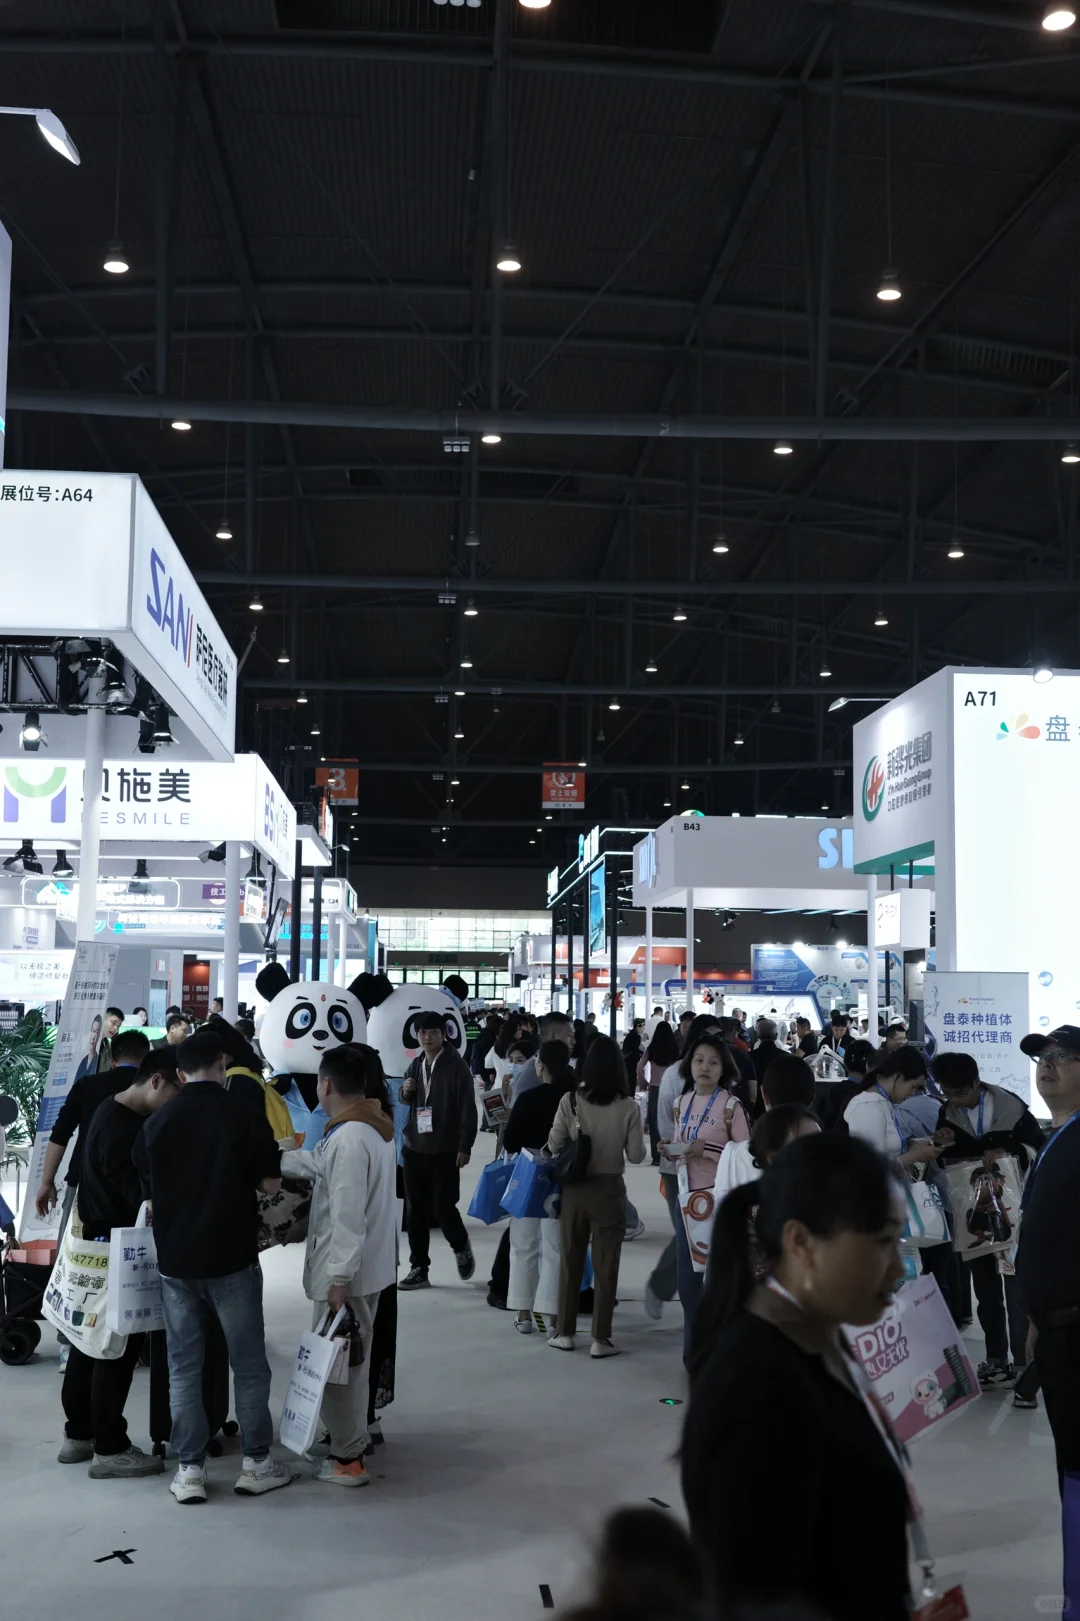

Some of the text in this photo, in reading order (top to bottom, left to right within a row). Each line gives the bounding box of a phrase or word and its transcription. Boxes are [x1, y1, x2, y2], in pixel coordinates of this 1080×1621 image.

[1, 485, 93, 503] 展位号:A64
[964, 691, 997, 706] A71
[81, 812, 190, 825] ESMILE
[684, 823, 701, 831] B43
[943, 1012, 1013, 1026] 盘泰种植体
[943, 1030, 1013, 1044] 诚招代理商
[68, 1270, 106, 1289] 无纺布
[856, 1319, 901, 1361] DIO
